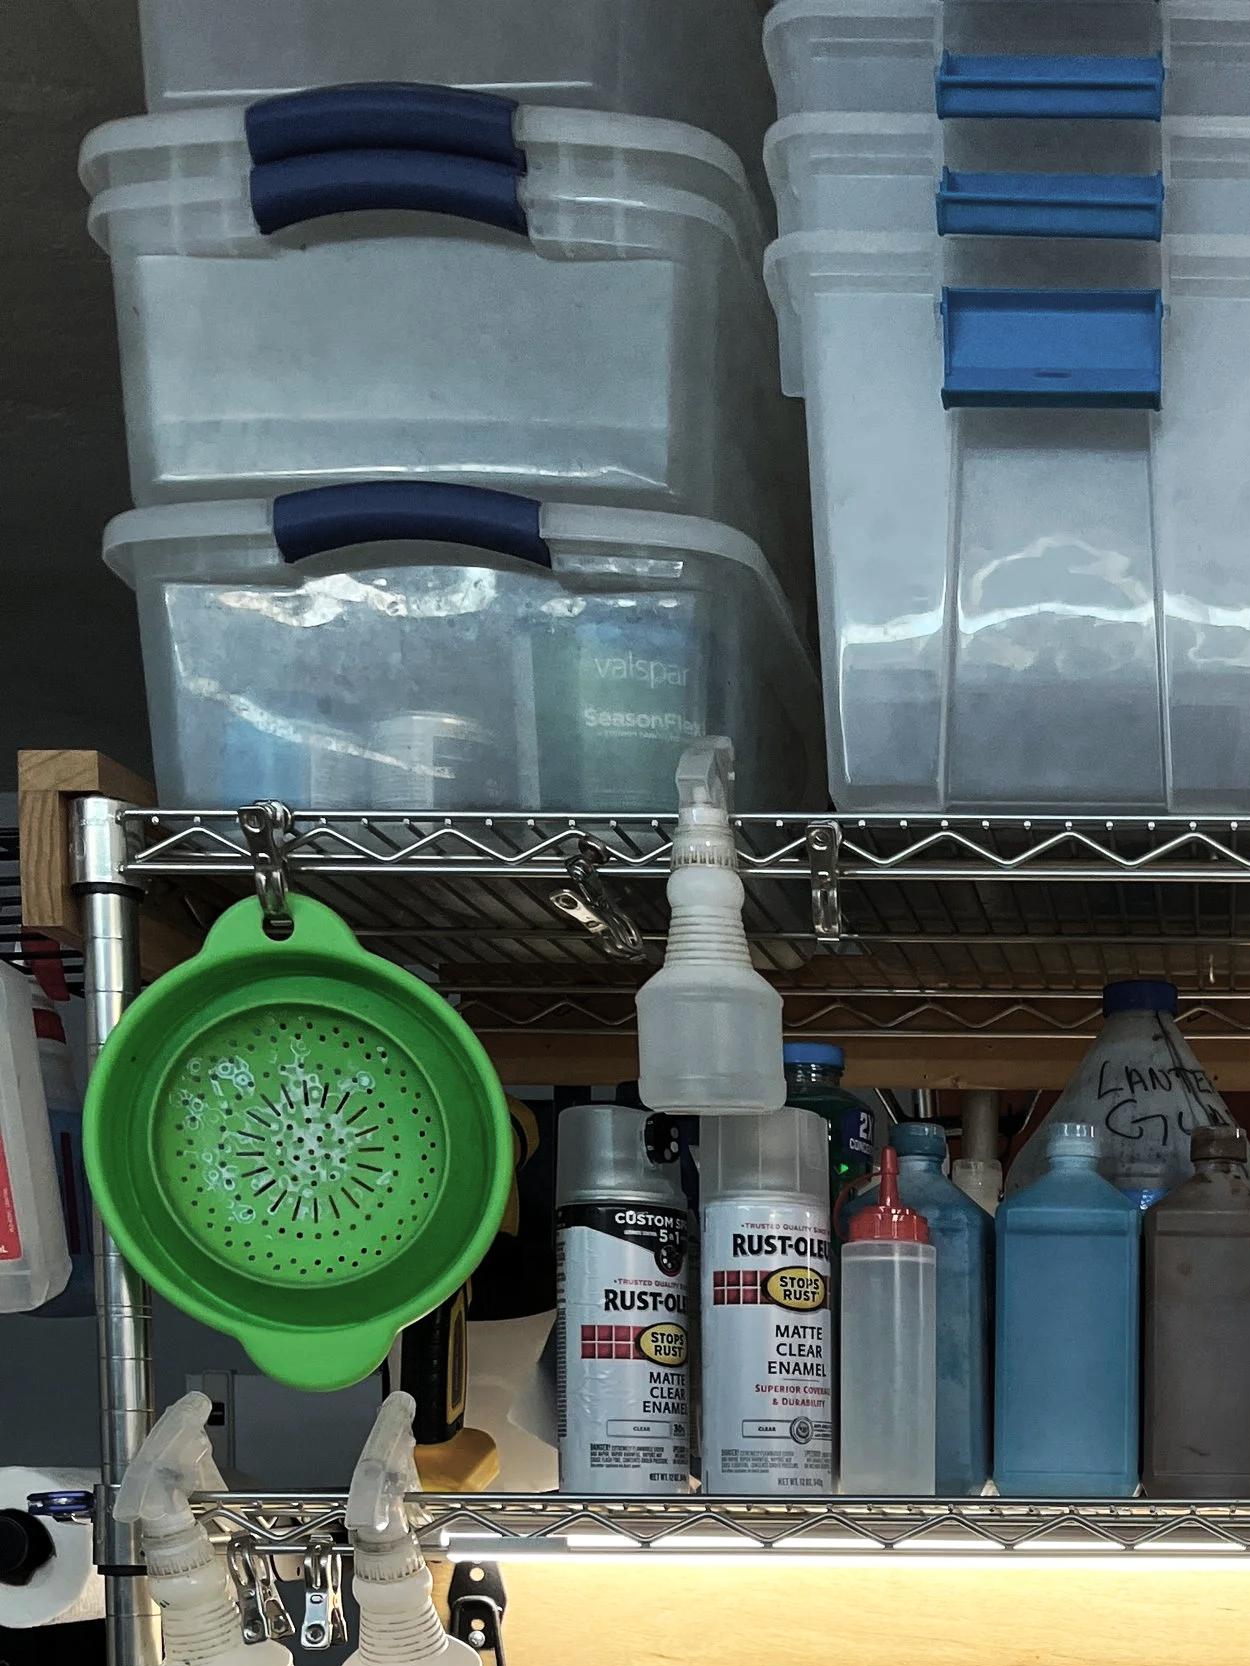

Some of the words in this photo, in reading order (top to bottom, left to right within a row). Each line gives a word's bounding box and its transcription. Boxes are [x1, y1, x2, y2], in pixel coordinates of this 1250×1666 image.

[594, 650, 689, 689] valspar
[615, 1210, 674, 1228] CUSTOM
[746, 1222, 781, 1230] TRUSTED
[783, 1224, 812, 1232] QUALITY
[659, 1229, 668, 1243] 5
[618, 1278, 652, 1286] TRUSTED
[780, 1276, 820, 1290] STOPS
[783, 1289, 817, 1302] RUST
[651, 1332, 684, 1346] STOPS
[776, 1325, 823, 1340] MATTE
[654, 1345, 682, 1358] RUST
[776, 1343, 823, 1358] CLEAR
[768, 1361, 826, 1377] ENAMEL
[650, 1372, 685, 1386] MATTE
[650, 1387, 685, 1400] CLEAR
[755, 1384, 800, 1393] SUPERIOR
[643, 1401, 688, 1415] ENAMEL
[782, 1398, 825, 1408] DURABILITY
